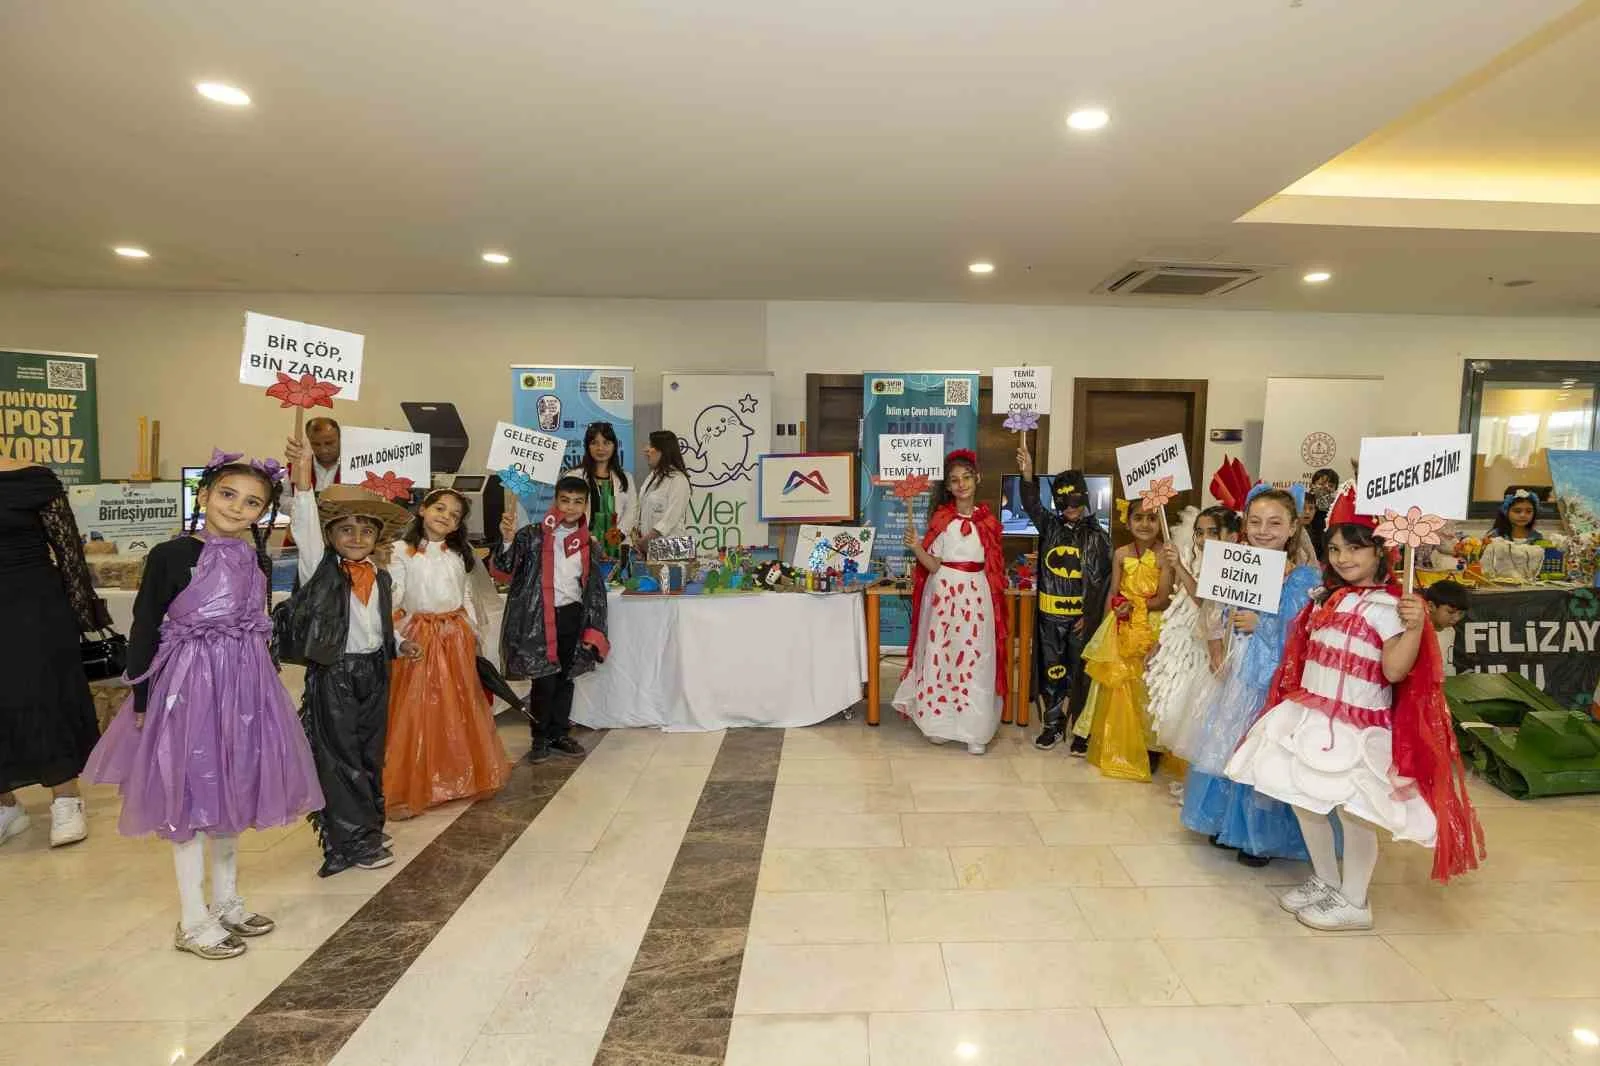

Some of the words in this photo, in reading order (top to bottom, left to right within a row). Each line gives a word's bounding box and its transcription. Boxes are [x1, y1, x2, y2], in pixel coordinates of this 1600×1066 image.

[267, 334, 298, 352] BİR
[303, 341, 342, 363] ÇÖP,
[250, 353, 282, 371] BİN
[288, 361, 354, 384] ZARAR!
[1013, 368, 1035, 378] TEMİZ
[1010, 379, 1037, 389] DÜNYA,
[1011, 392, 1036, 400] MUTLU
[0, 409, 74, 437] POST
[890, 437, 932, 449] ÇEVREYİ
[350, 453, 374, 470] ATMA
[375, 440, 423, 464] DÖNÜŞTÜR!
[511, 446, 545, 462] NEFES
[900, 453, 922, 463] SEV,
[1126, 443, 1179, 487] DÖNÜŞTÜR!
[1366, 464, 1421, 500] GELECEK
[1423, 449, 1461, 483] BİZİM!
[99, 503, 178, 522] Birleşiyoruz!
[684, 492, 748, 525] Mer
[1223, 548, 1262, 566] DOĞA
[1221, 566, 1258, 585] BİZİM
[1211, 584, 1262, 606] EVİMİZ!
